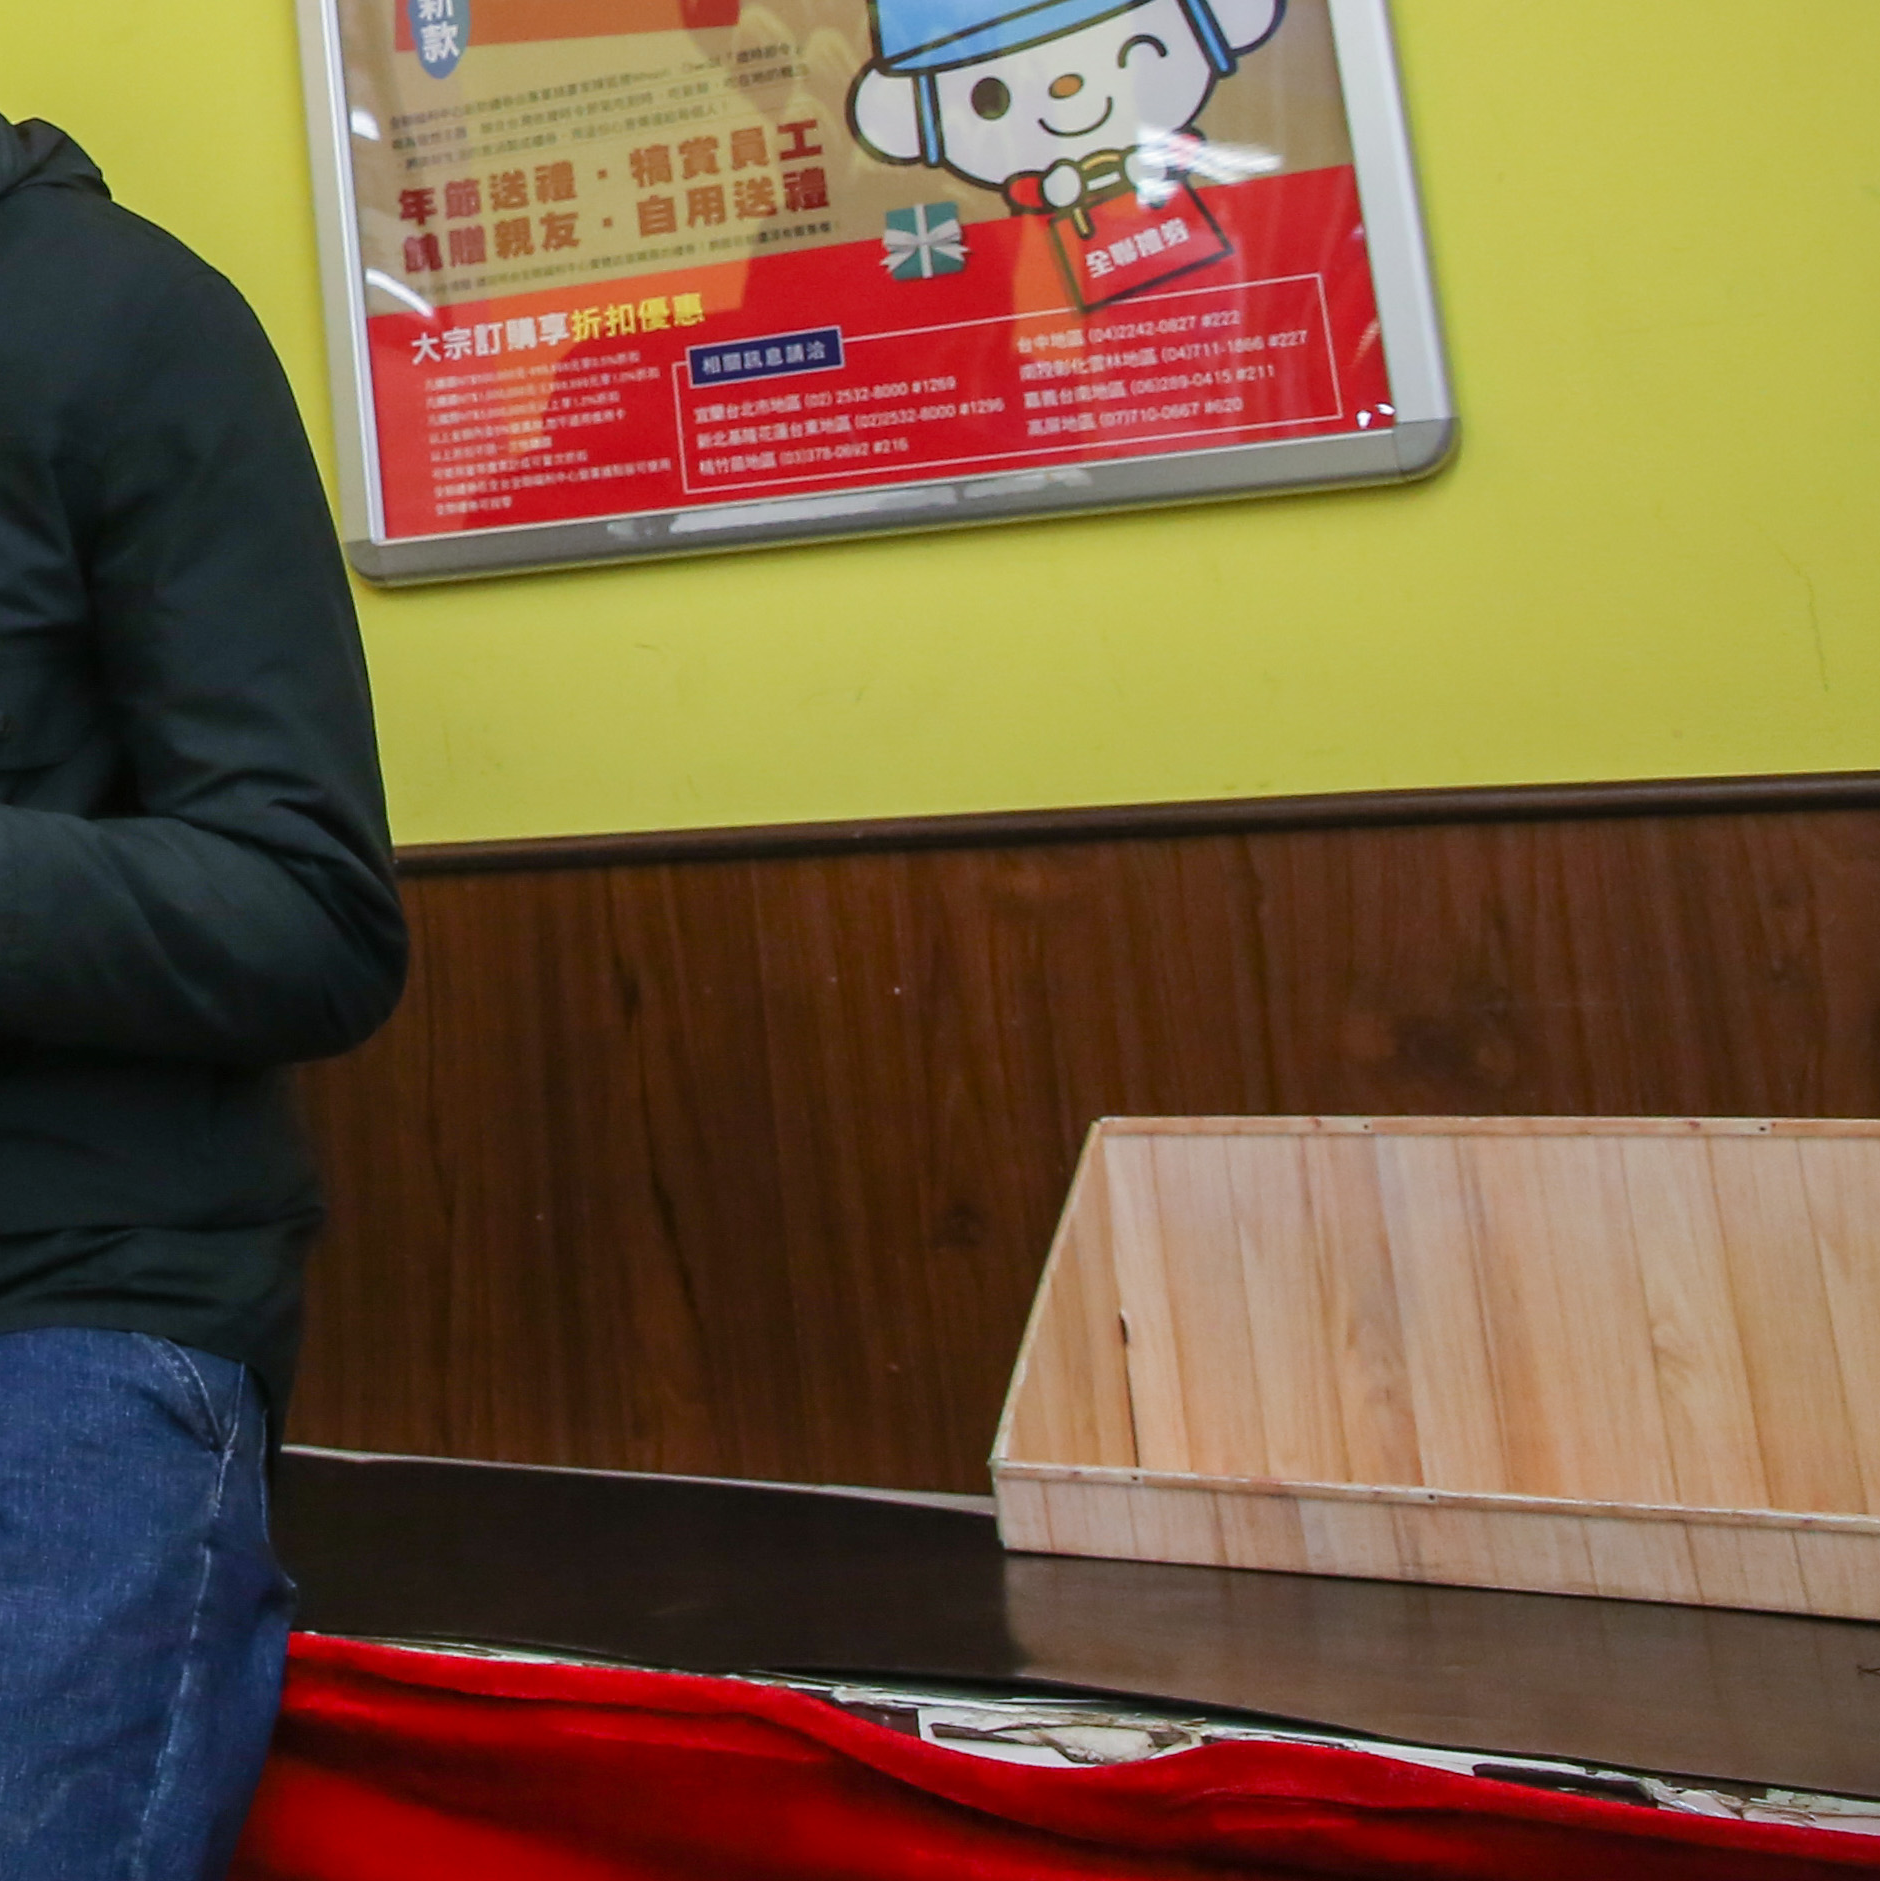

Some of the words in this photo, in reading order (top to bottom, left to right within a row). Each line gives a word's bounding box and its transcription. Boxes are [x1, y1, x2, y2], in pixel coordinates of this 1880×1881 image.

[1082, 218, 1192, 279] 全聯禮券
[410, 292, 706, 365] 大宗訂購享折扣優惠
